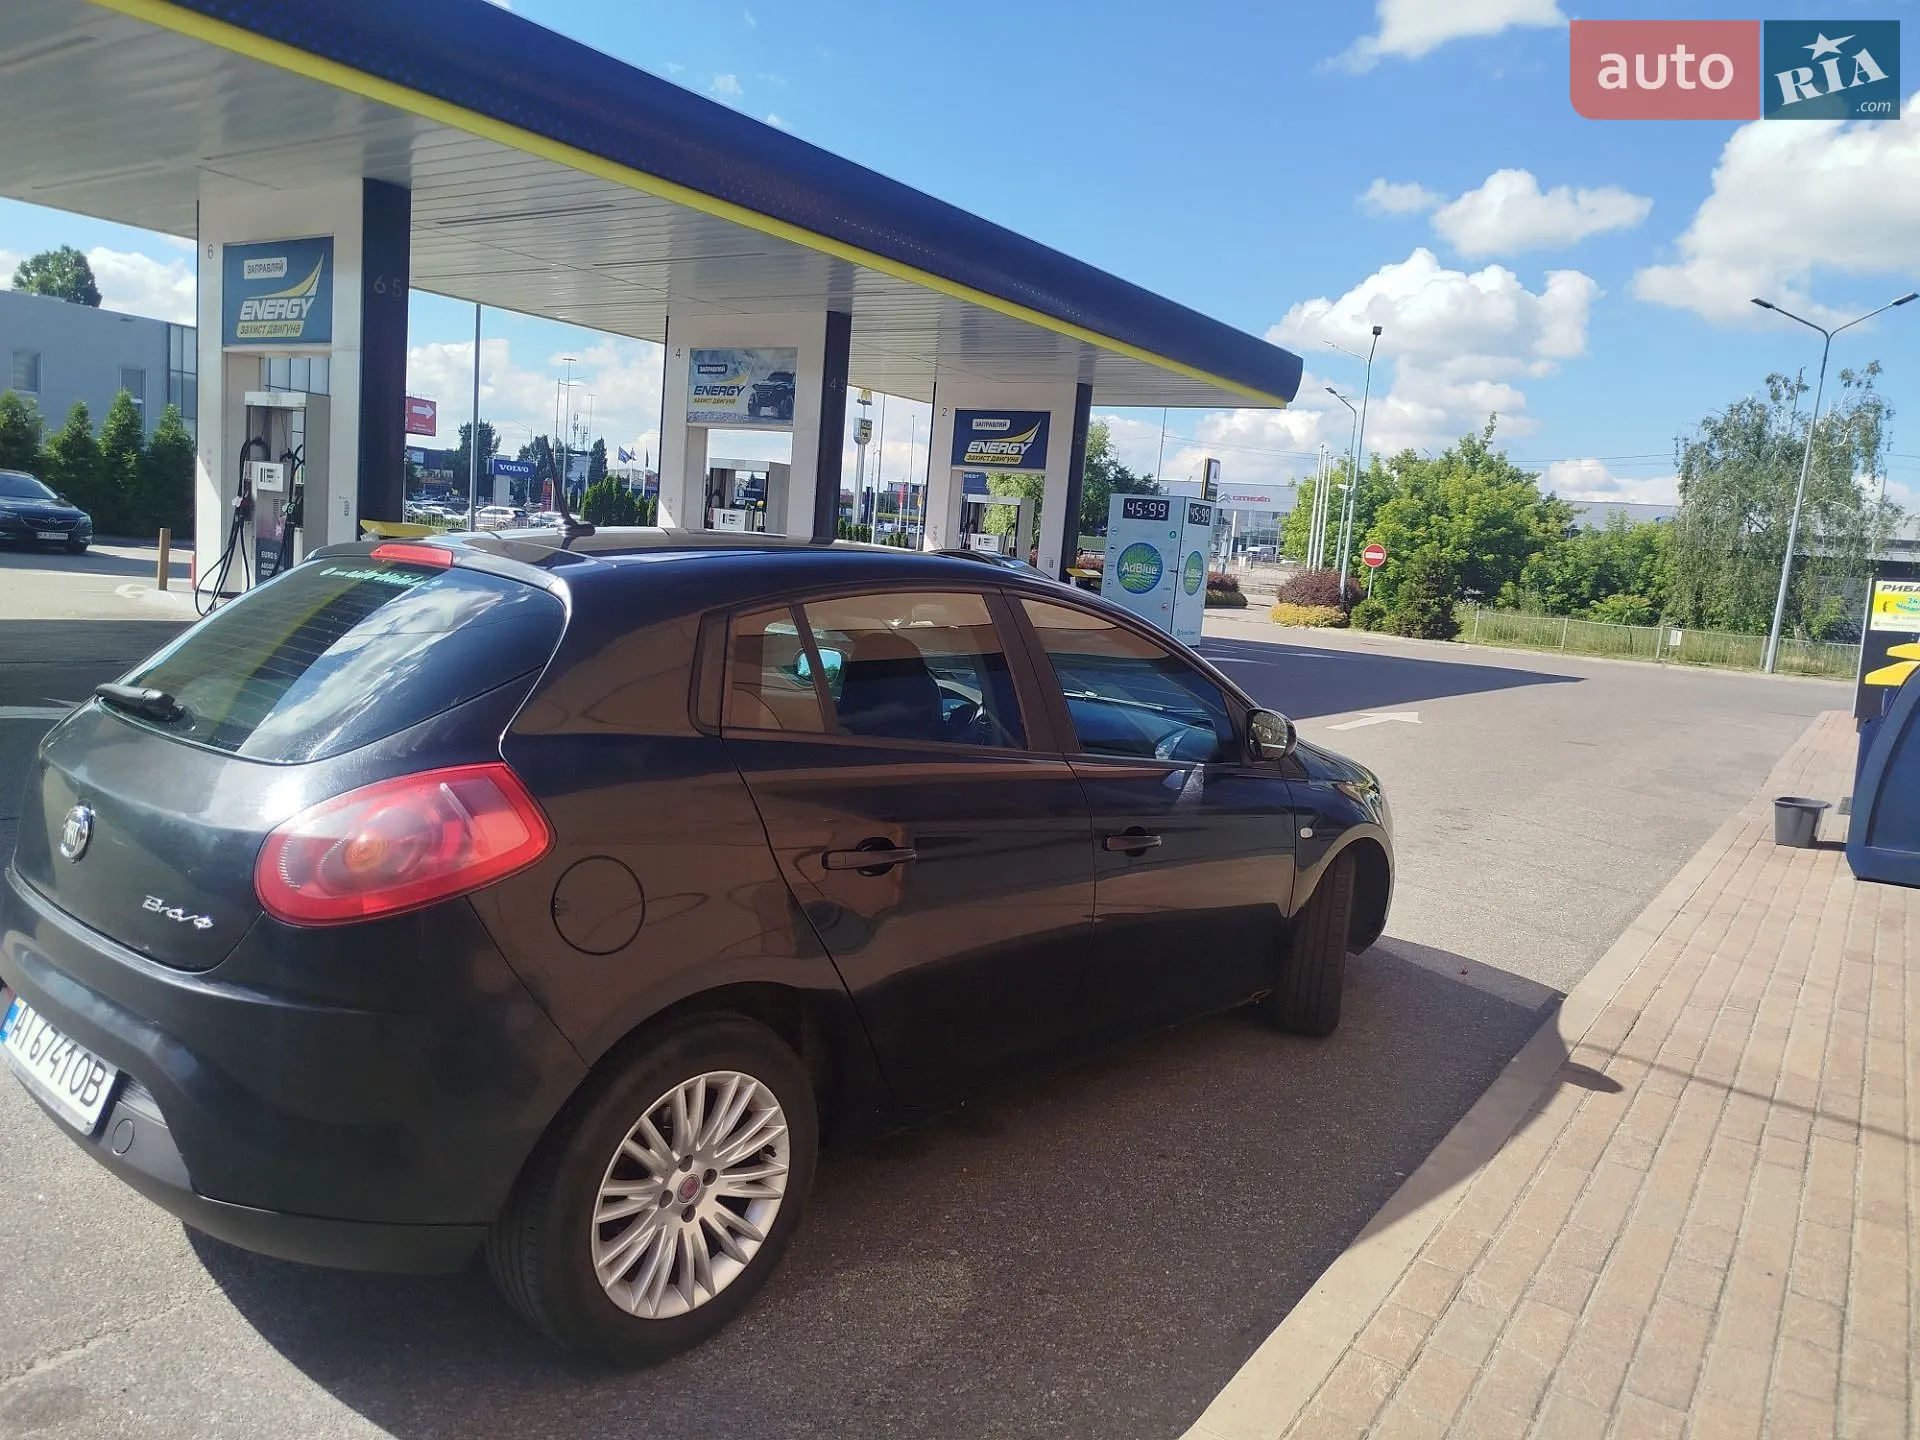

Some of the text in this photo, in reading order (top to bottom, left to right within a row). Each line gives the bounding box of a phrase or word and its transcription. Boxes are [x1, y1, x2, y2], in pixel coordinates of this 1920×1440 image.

[207, 244, 214, 259] 6
[247, 260, 285, 274] ЗАПРАВЛЯЙ
[240, 298, 315, 320] ENERGY
[675, 348, 682, 359] 4
[694, 385, 745, 396] ENERGY
[942, 407, 948, 417] 2
[968, 441, 1031, 454] ENERGY
[499, 464, 529, 473] VOLVO
[1122, 562, 1158, 574] AdBlue
